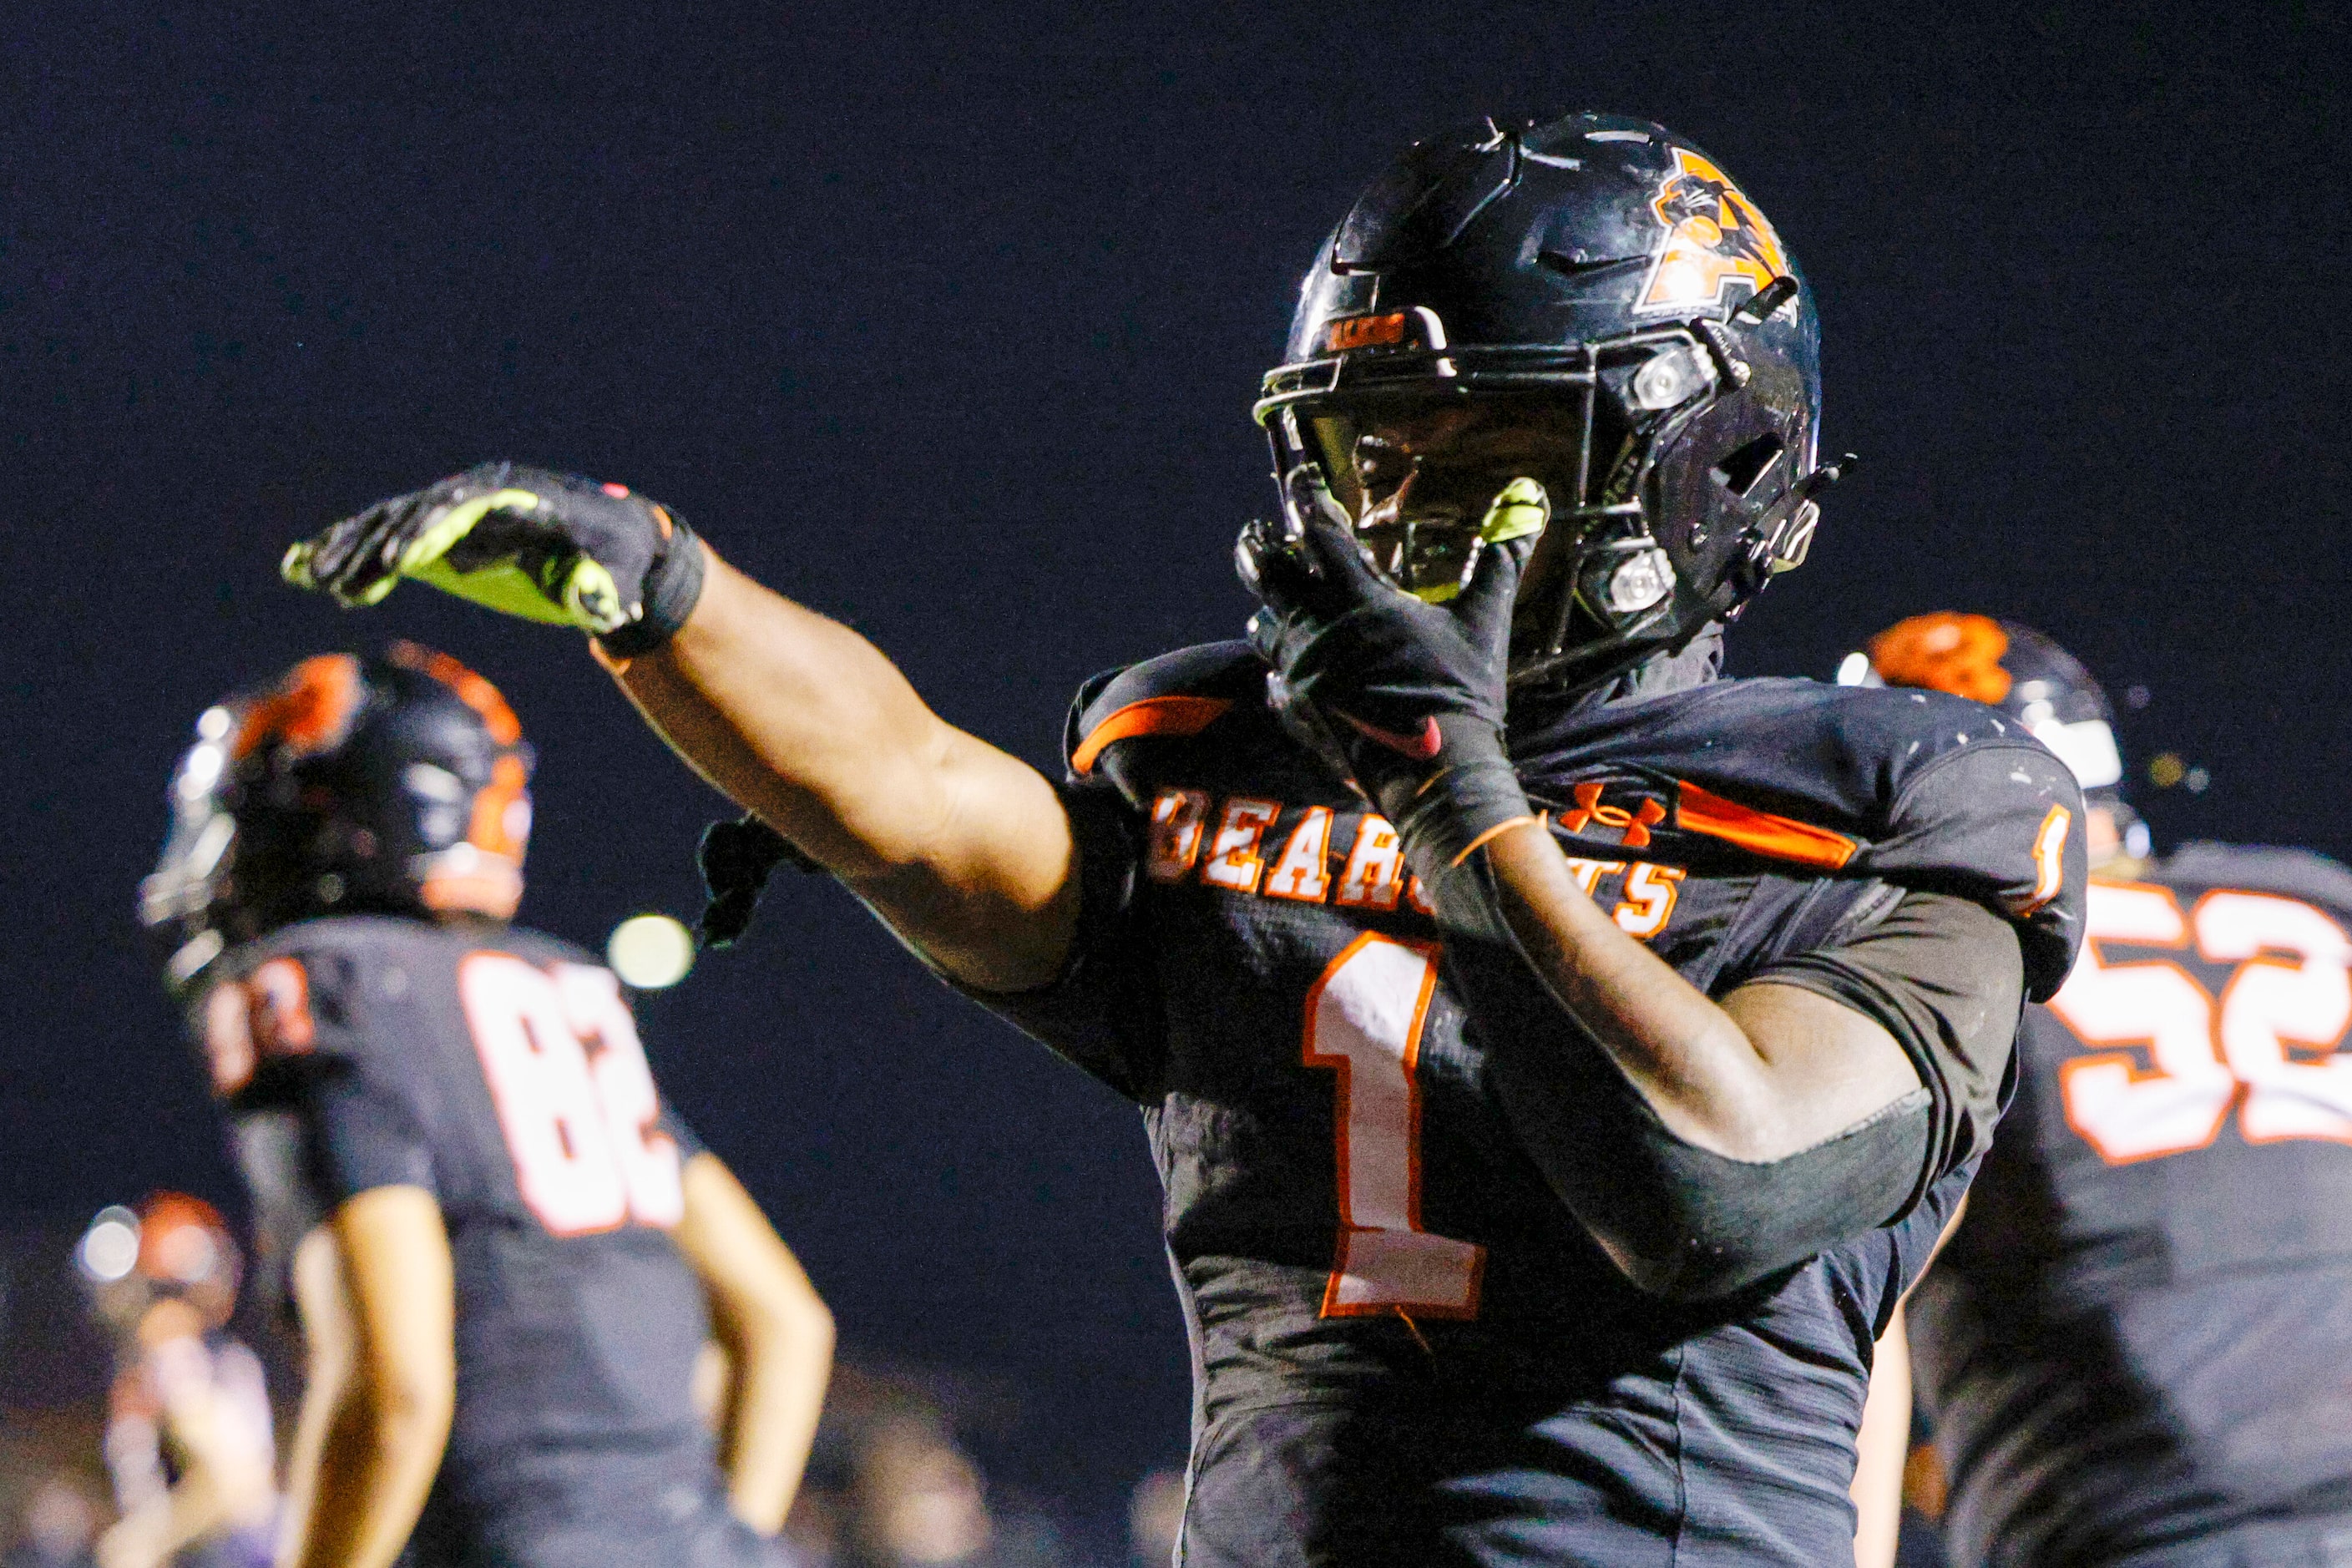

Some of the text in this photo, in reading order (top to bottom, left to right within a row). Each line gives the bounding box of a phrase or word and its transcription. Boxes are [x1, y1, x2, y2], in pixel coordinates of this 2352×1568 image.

[2025, 802, 2071, 908] 1
[457, 948, 685, 1237] 82
[1302, 929, 1487, 1320] 1
[2044, 877, 2352, 1167] 52
